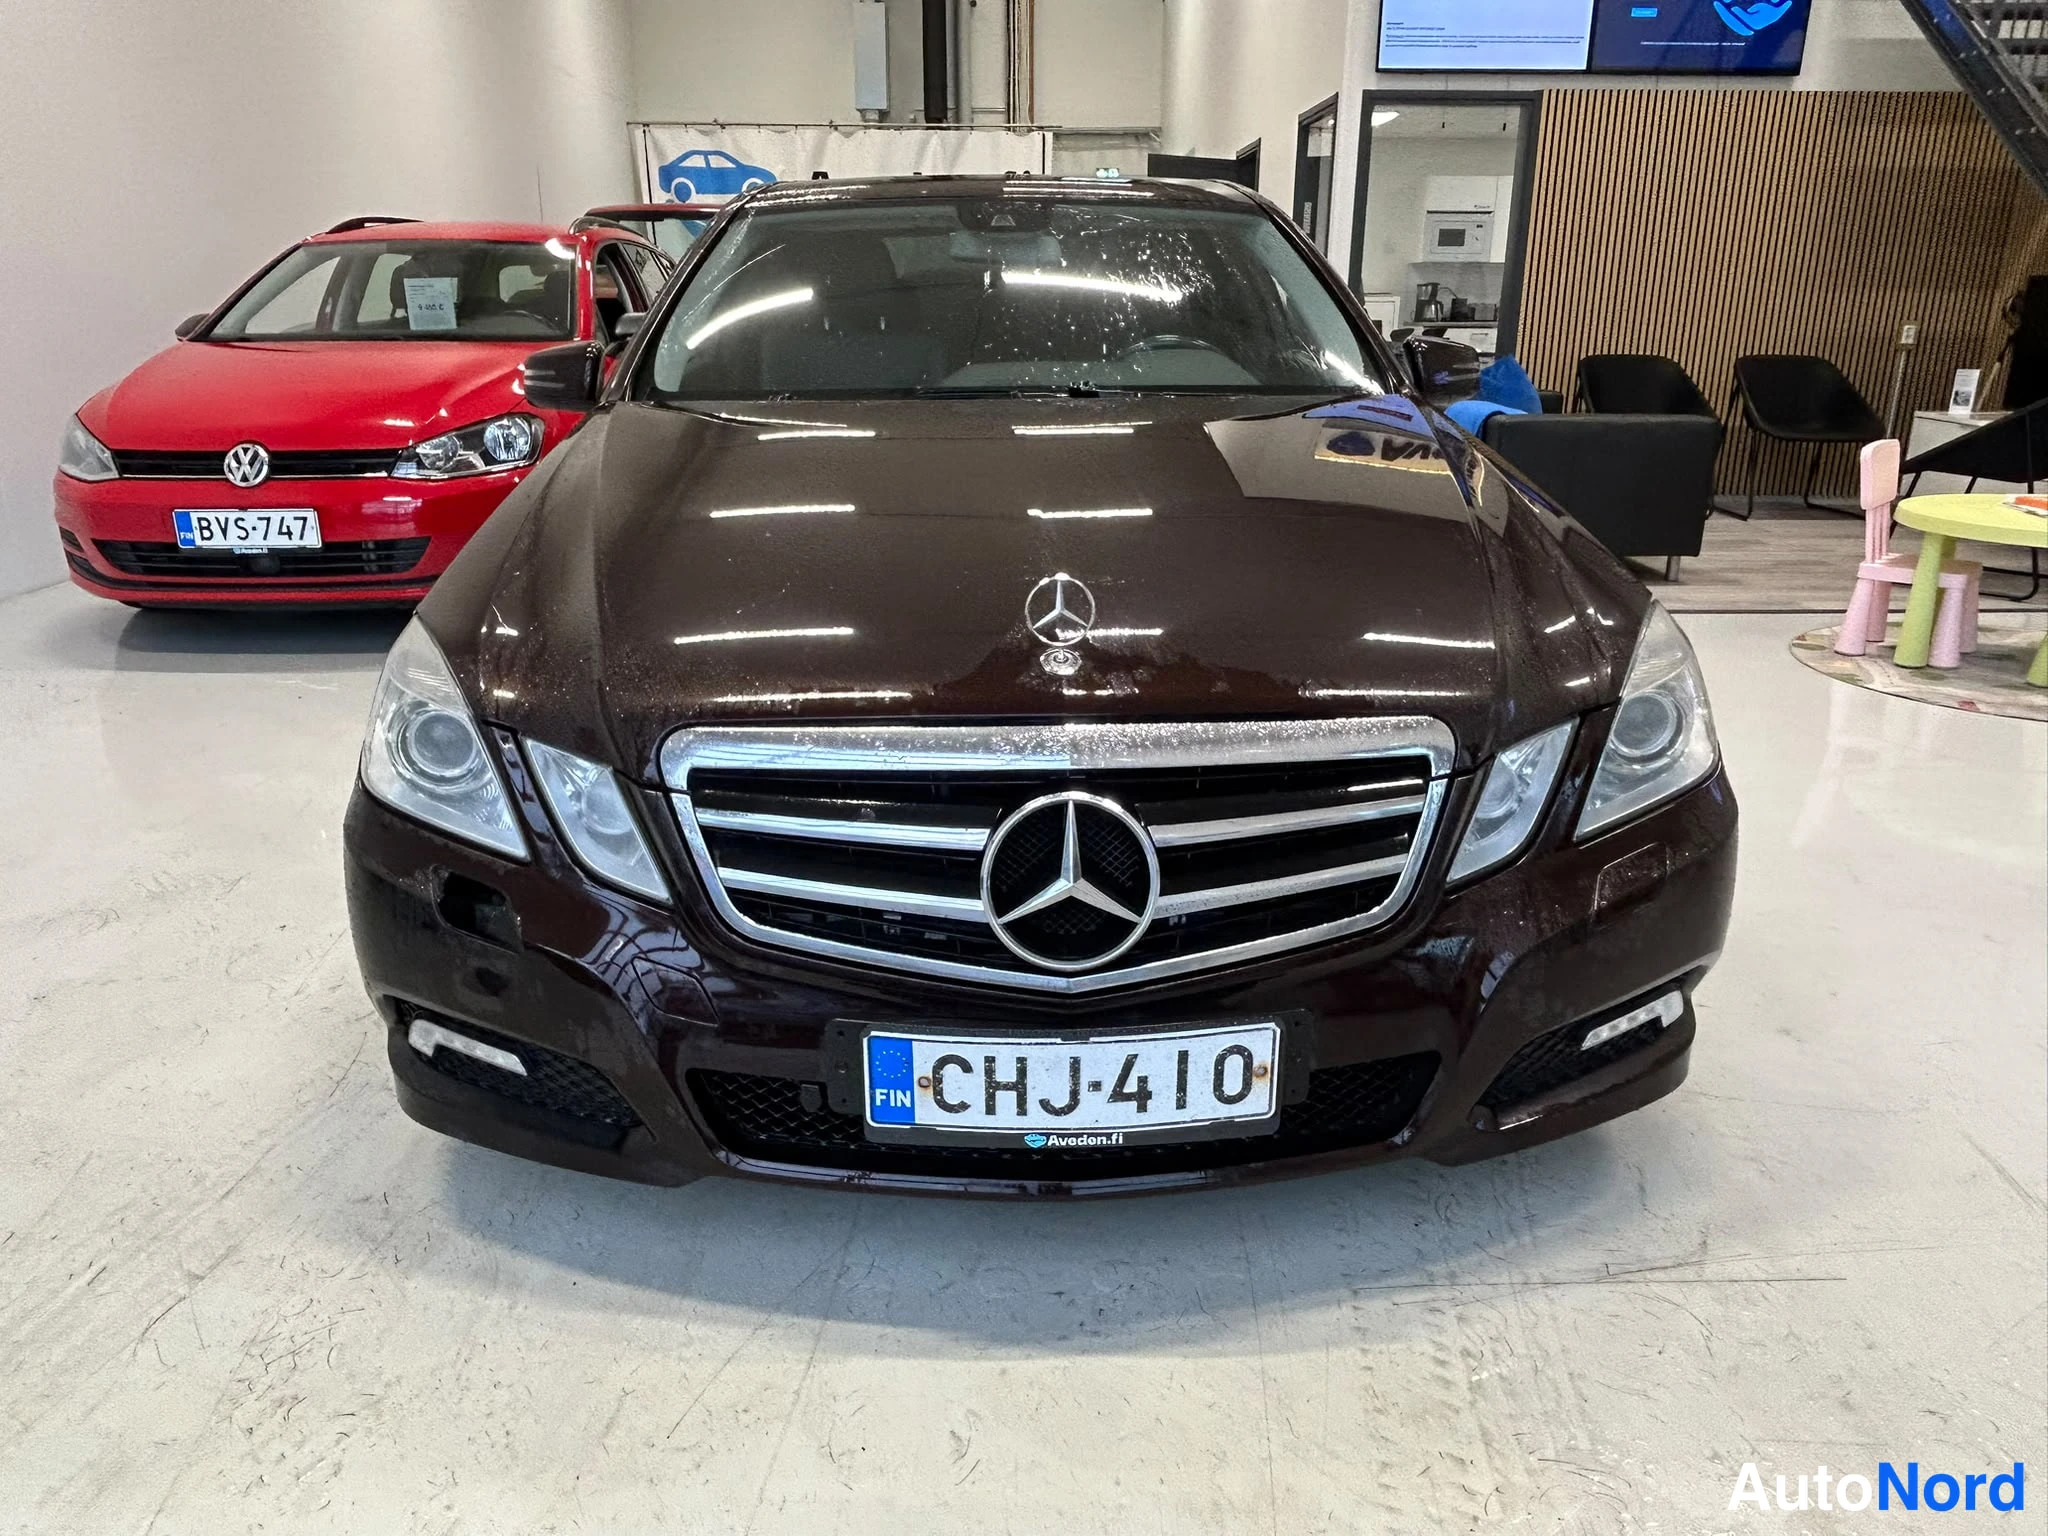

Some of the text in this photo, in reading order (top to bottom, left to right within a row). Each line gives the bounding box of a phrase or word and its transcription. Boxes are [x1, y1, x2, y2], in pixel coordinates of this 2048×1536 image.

[197, 516, 308, 541] BVS-747
[875, 1045, 1254, 1116] FIN CHJ-410
